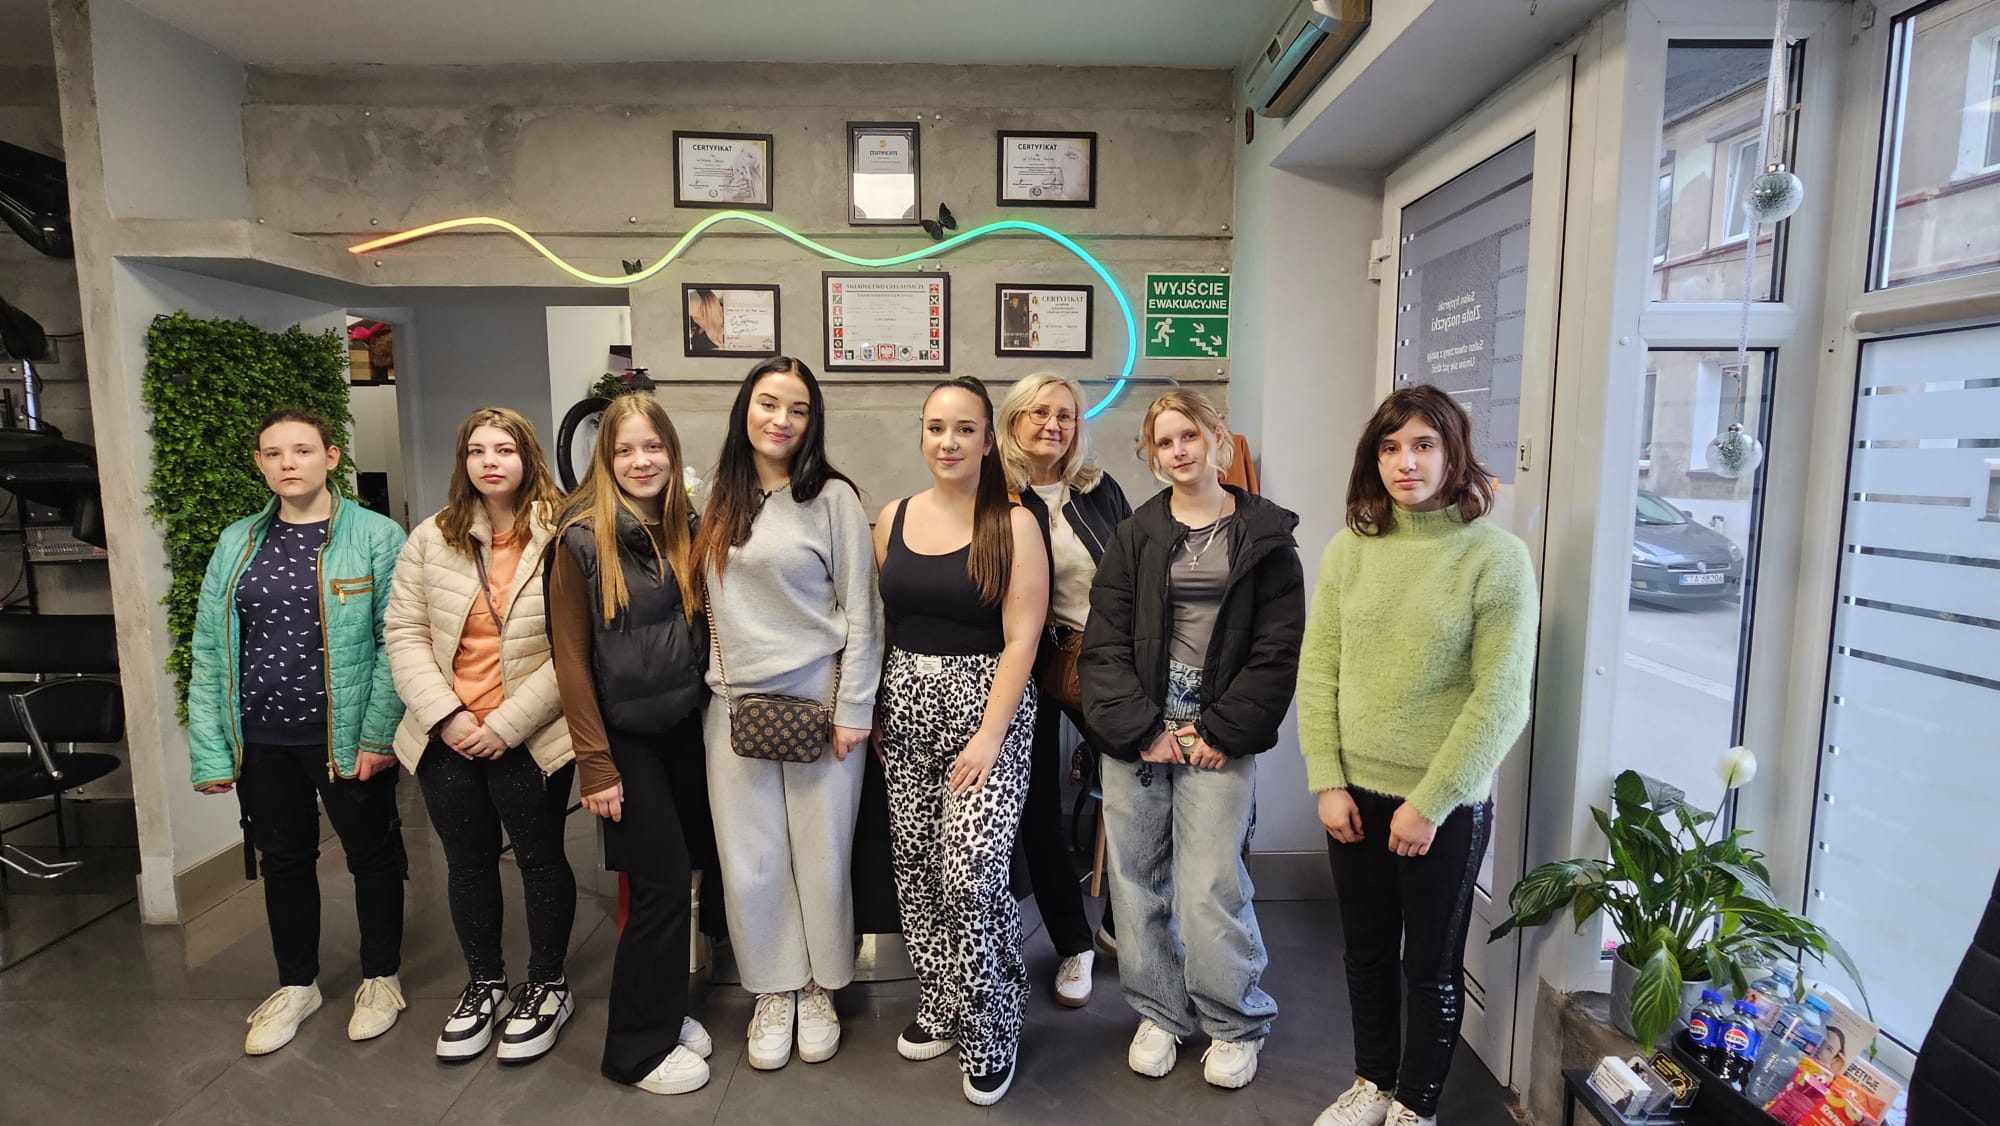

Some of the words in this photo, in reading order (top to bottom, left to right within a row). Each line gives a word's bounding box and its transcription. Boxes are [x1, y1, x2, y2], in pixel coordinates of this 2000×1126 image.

[692, 144, 732, 152] CERTYFIKAT
[1017, 143, 1058, 151] CERTYFIKAT
[1153, 279, 1224, 296] WYJŚCIE
[1148, 299, 1227, 309] EWAKUACYJNE
[1725, 1034, 1748, 1047] PEPSI
